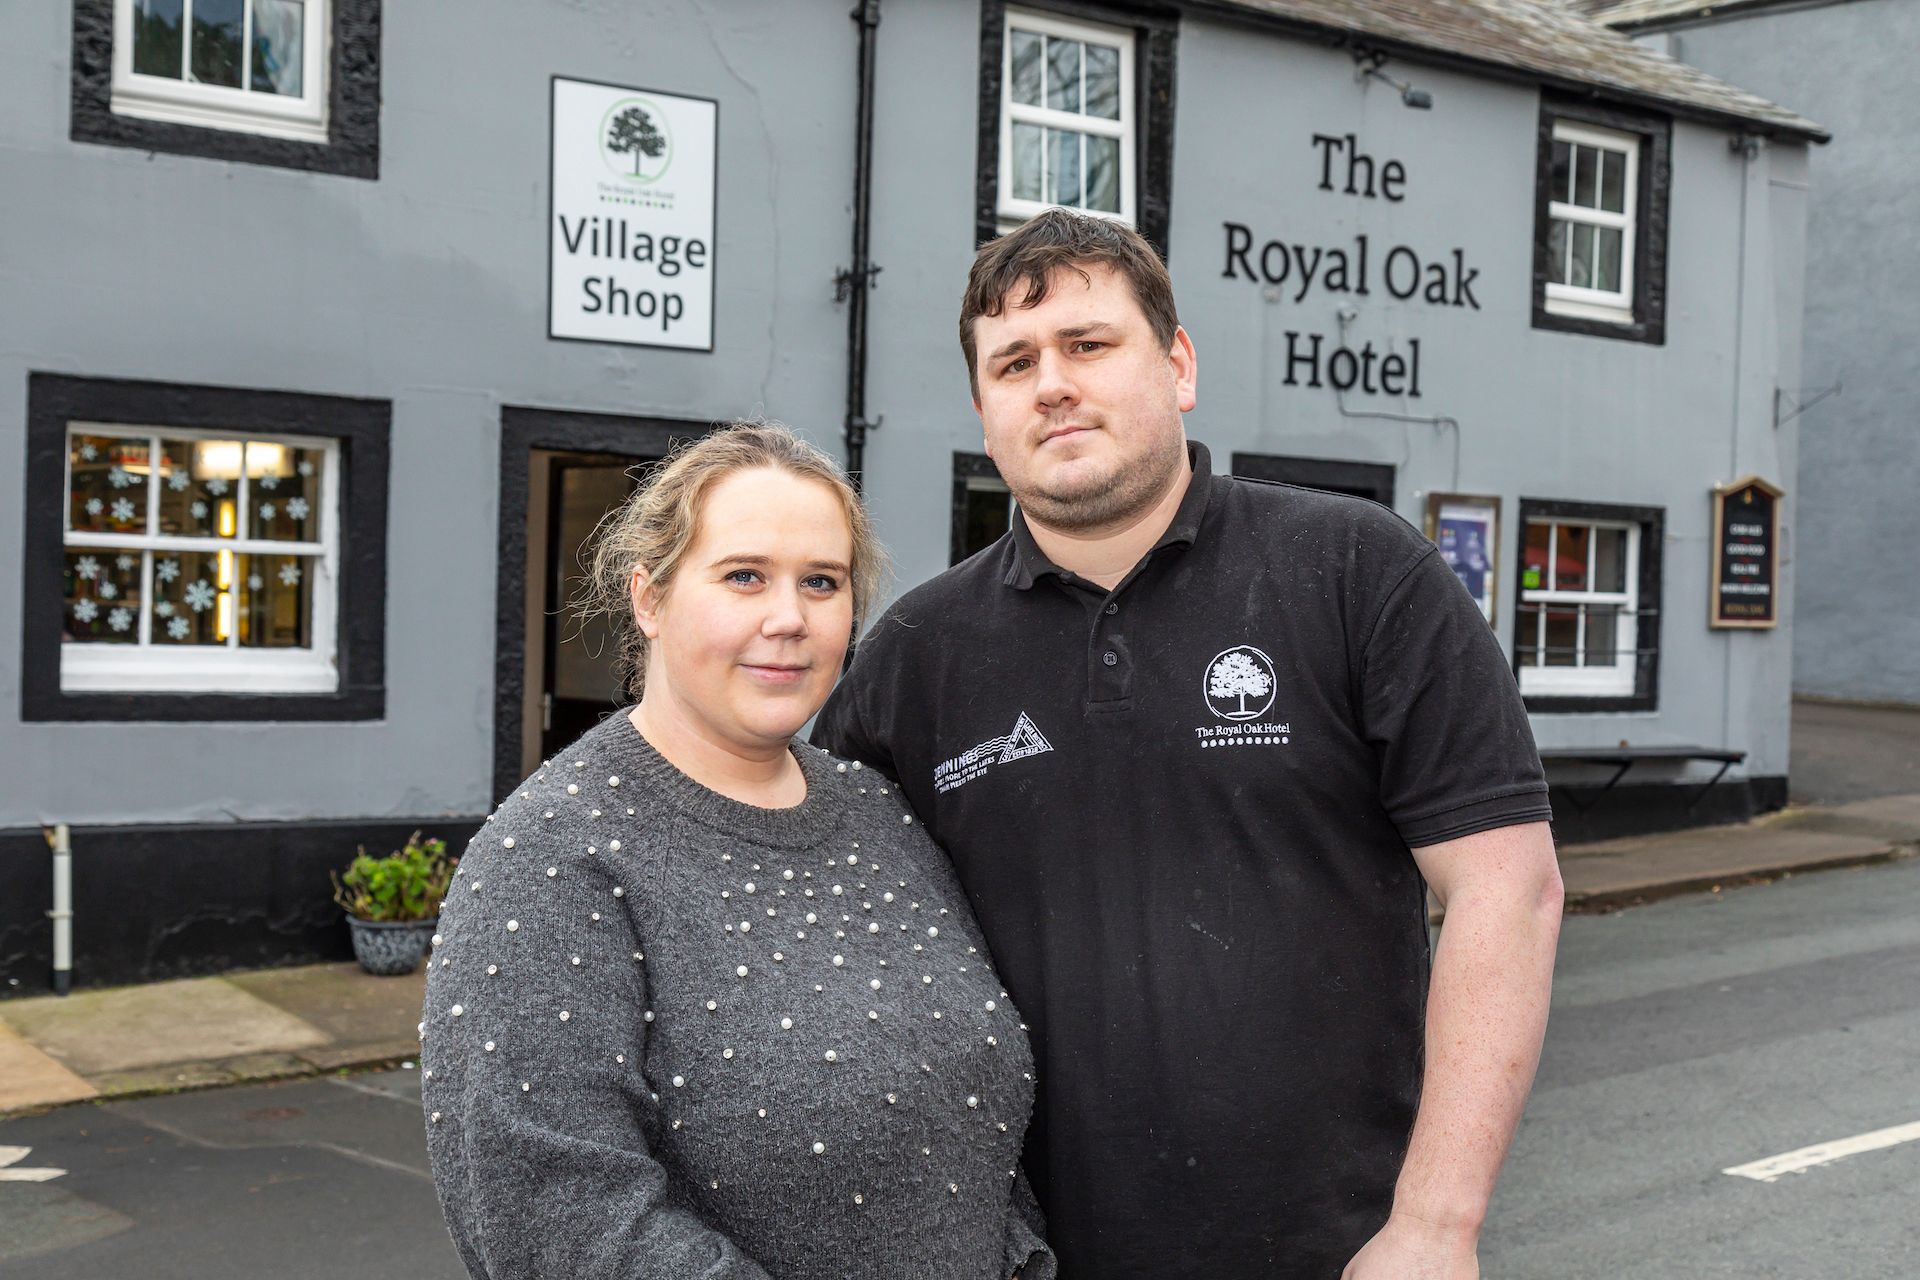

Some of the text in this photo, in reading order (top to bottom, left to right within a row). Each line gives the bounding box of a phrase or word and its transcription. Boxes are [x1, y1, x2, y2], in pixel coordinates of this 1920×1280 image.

[1312, 134, 1406, 203] The
[558, 214, 707, 278] Village
[1221, 221, 1481, 310] Royal Oak
[582, 275, 684, 332] Shop
[1282, 331, 1422, 398] Hotel
[1195, 722, 1290, 738] The Royal Oak Hotel
[933, 750, 979, 779] JENNINGS
[945, 756, 995, 783] MORE TO THE LAKES
[966, 773, 977, 782] THE
[976, 766, 988, 777] EYE
